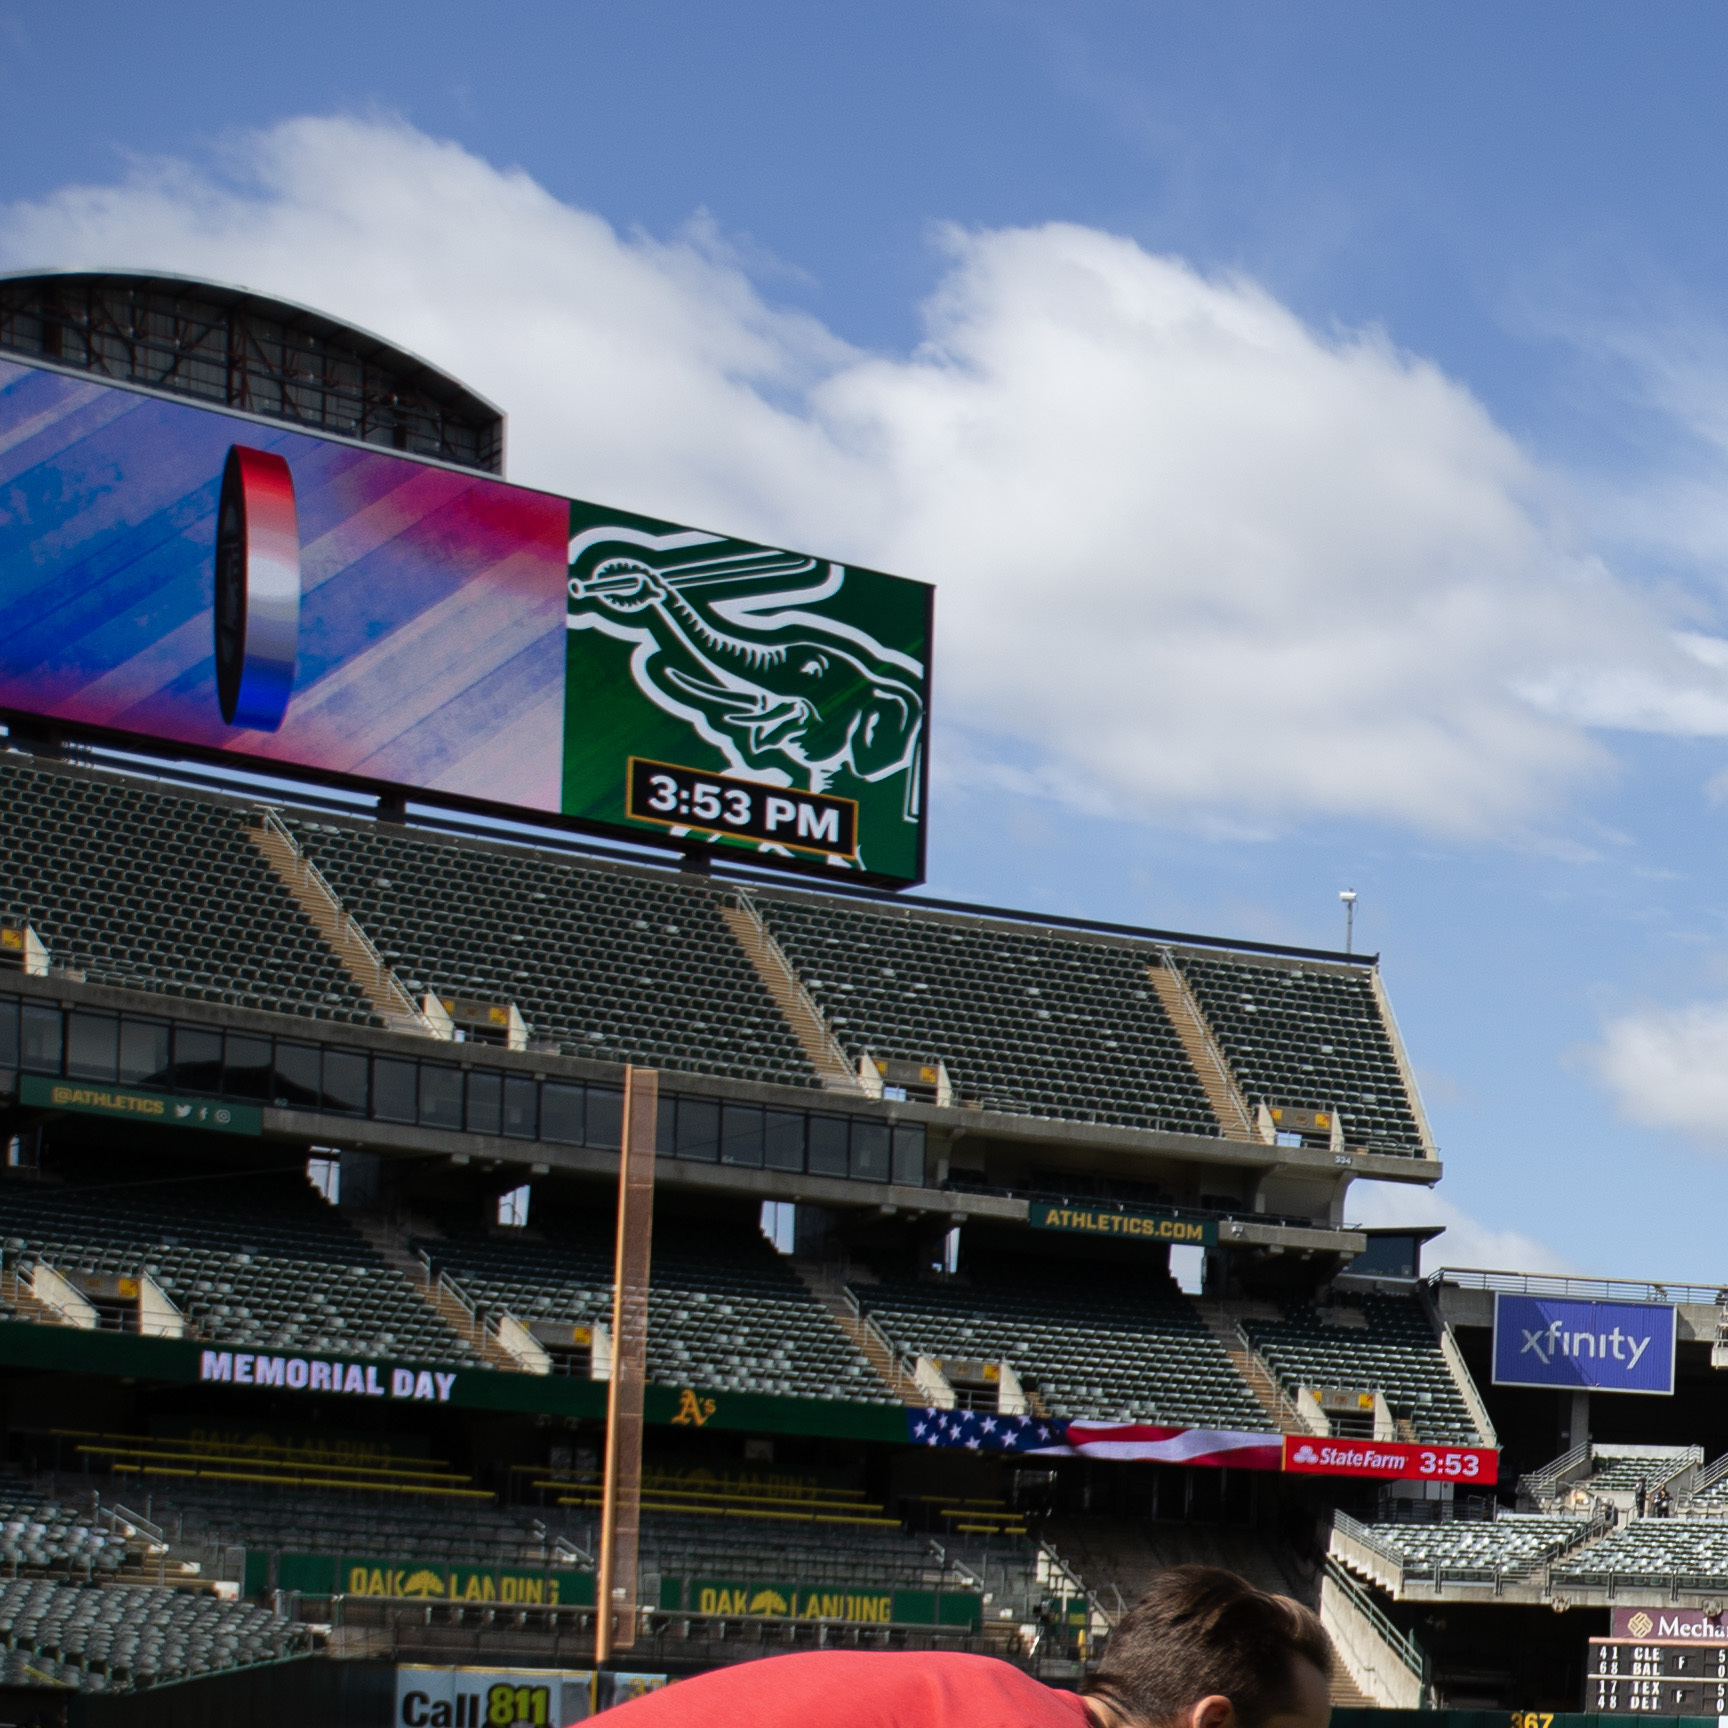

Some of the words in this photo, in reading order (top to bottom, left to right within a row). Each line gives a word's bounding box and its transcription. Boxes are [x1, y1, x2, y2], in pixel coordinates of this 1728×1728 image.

[648, 774, 751, 826] 3:53
[764, 796, 840, 843] PM
[52, 1086, 164, 1115] @ATHLETICS
[1046, 1208, 1203, 1240] ATHLETICS.COM
[1520, 1320, 1651, 1370] xfinity
[201, 1350, 385, 1396] MEMORIAL
[391, 1368, 457, 1401] DAY
[1419, 1451, 1480, 1477] 3:53
[351, 1567, 404, 1598] OAK
[701, 1588, 747, 1616] OAK
[1600, 1646, 1618, 1660] 41
[1634, 1647, 1660, 1661] CLE
[1718, 1649, 1726, 1663] 5
[1678, 1656, 1685, 1670] F
[1600, 1662, 1618, 1675] 68
[1633, 1662, 1660, 1676] BAL
[1718, 1665, 1726, 1678] 0
[1600, 1680, 1617, 1694] 17
[1633, 1681, 1660, 1695] TEX
[1717, 1683, 1725, 1697] 5
[1676, 1690, 1683, 1703] F
[402, 1690, 480, 1728] Call
[488, 1682, 551, 1726] 811
[1597, 1696, 1617, 1709] 48
[1630, 1696, 1658, 1711] DET
[1716, 1699, 1724, 1712] 0
